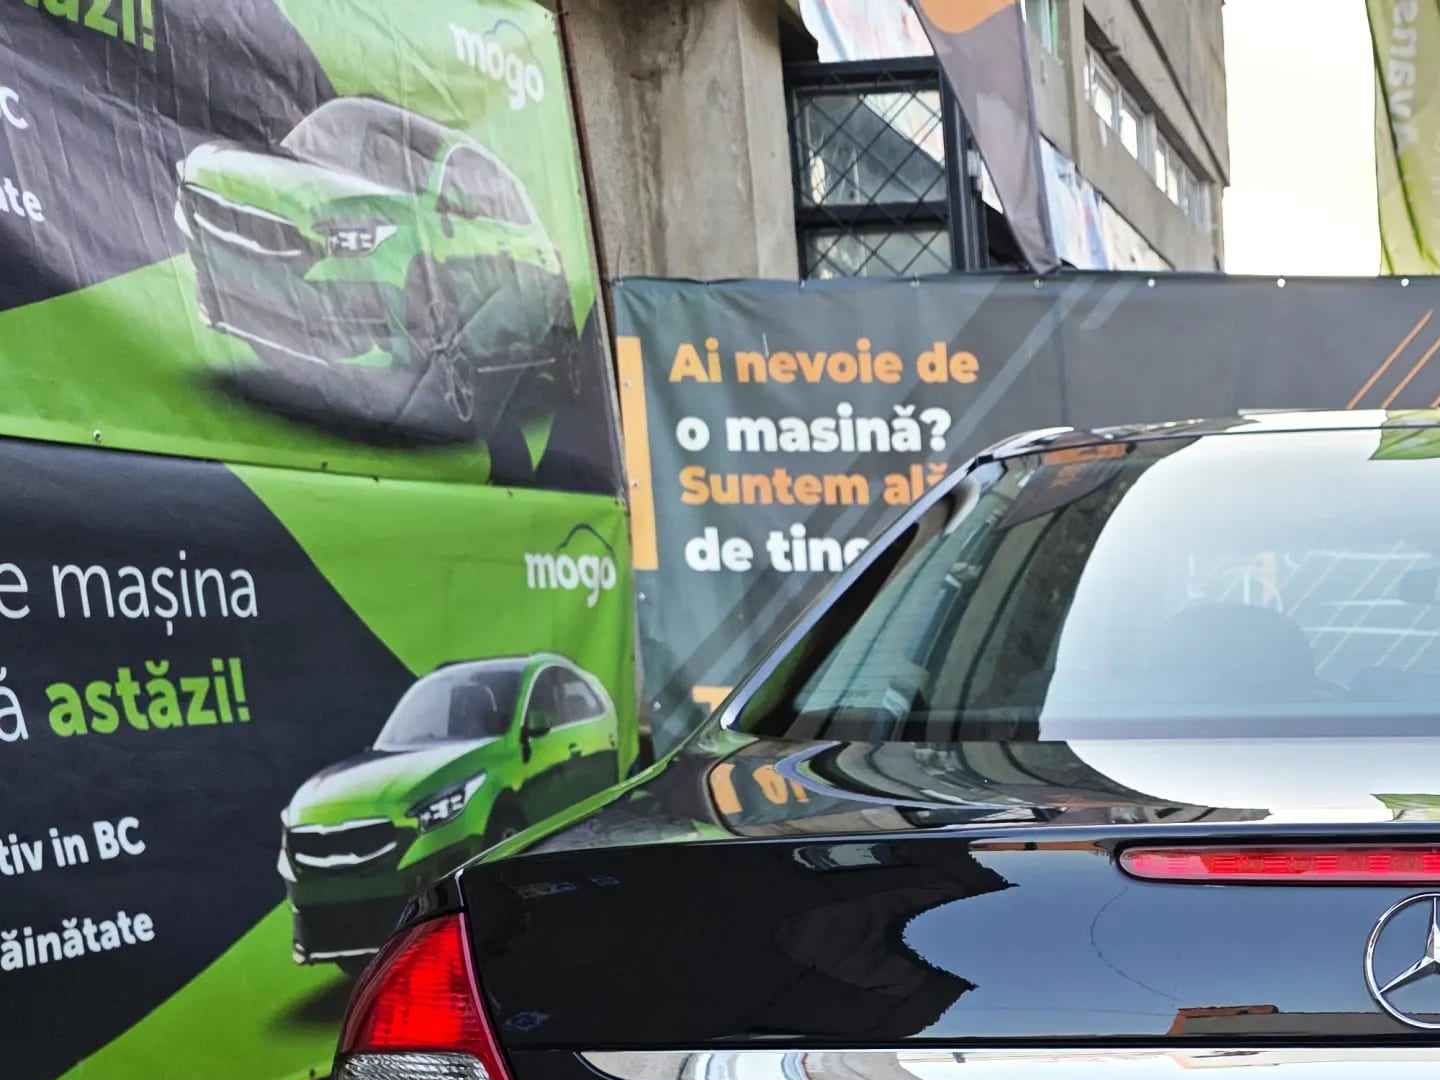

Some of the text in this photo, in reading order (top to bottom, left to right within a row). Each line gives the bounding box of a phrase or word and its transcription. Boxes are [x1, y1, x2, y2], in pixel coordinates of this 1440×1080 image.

[448, 22, 545, 110] mogo
[668, 337, 980, 383] Ai nevoie de
[676, 402, 952, 452] o masină?
[678, 464, 870, 505] Suntem
[684, 526, 754, 572] de
[52, 549, 259, 637] mașina
[525, 551, 617, 607] mogo
[45, 657, 251, 737] astăzi!
[49, 827, 90, 868] in
[92, 816, 147, 861] BC
[0, 910, 156, 972] ăinătate
